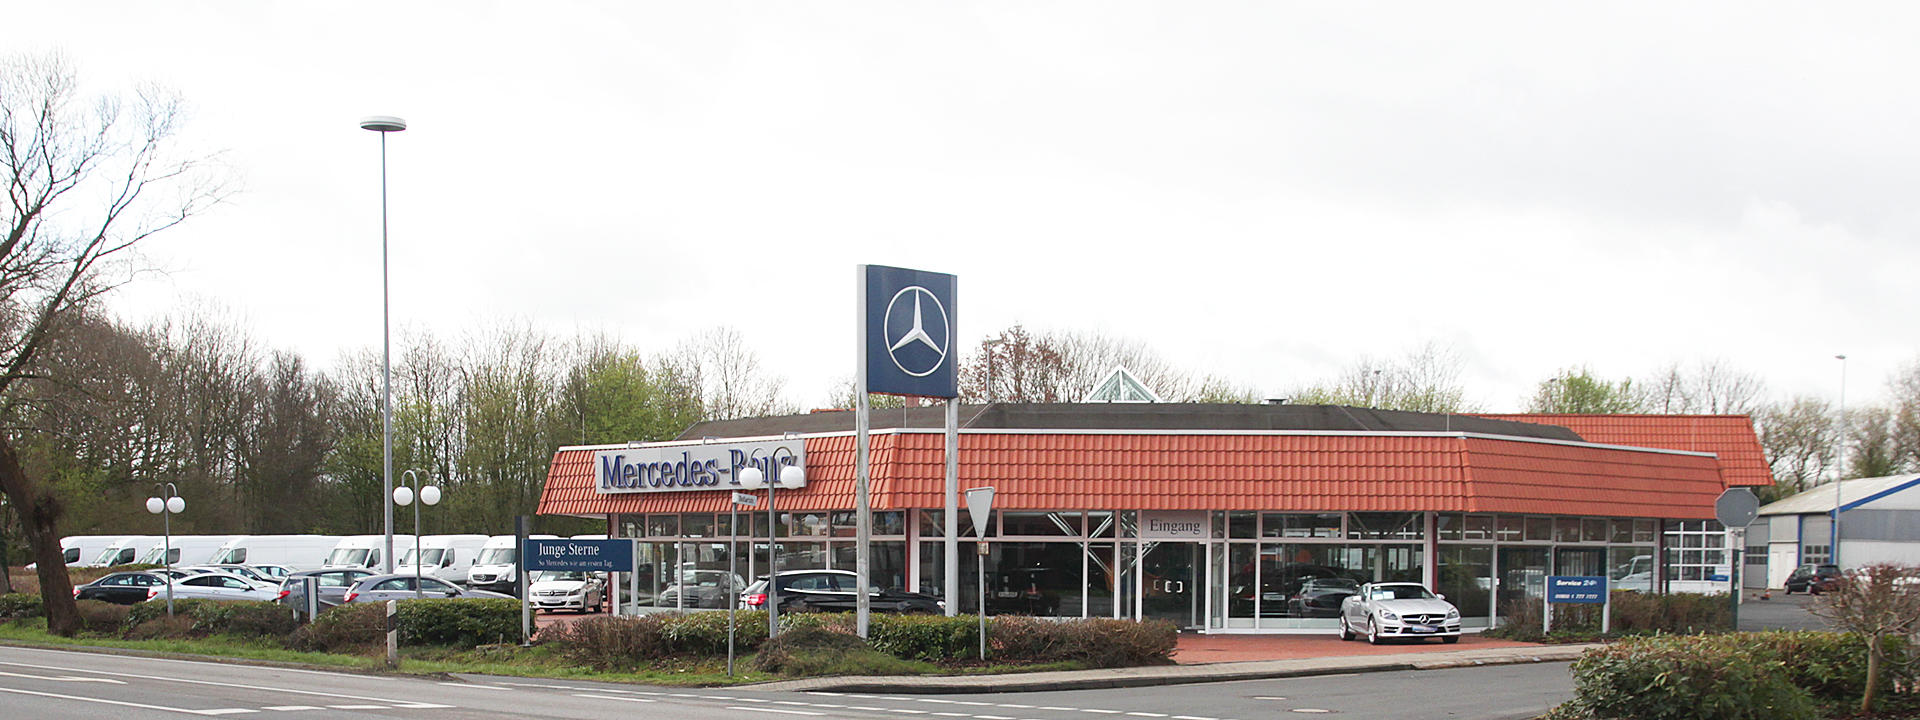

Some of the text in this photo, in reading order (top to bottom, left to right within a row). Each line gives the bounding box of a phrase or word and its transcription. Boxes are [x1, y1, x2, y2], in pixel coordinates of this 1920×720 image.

[1150, 519, 1201, 535] Eingang
[539, 542, 600, 558] Junge Sterne
